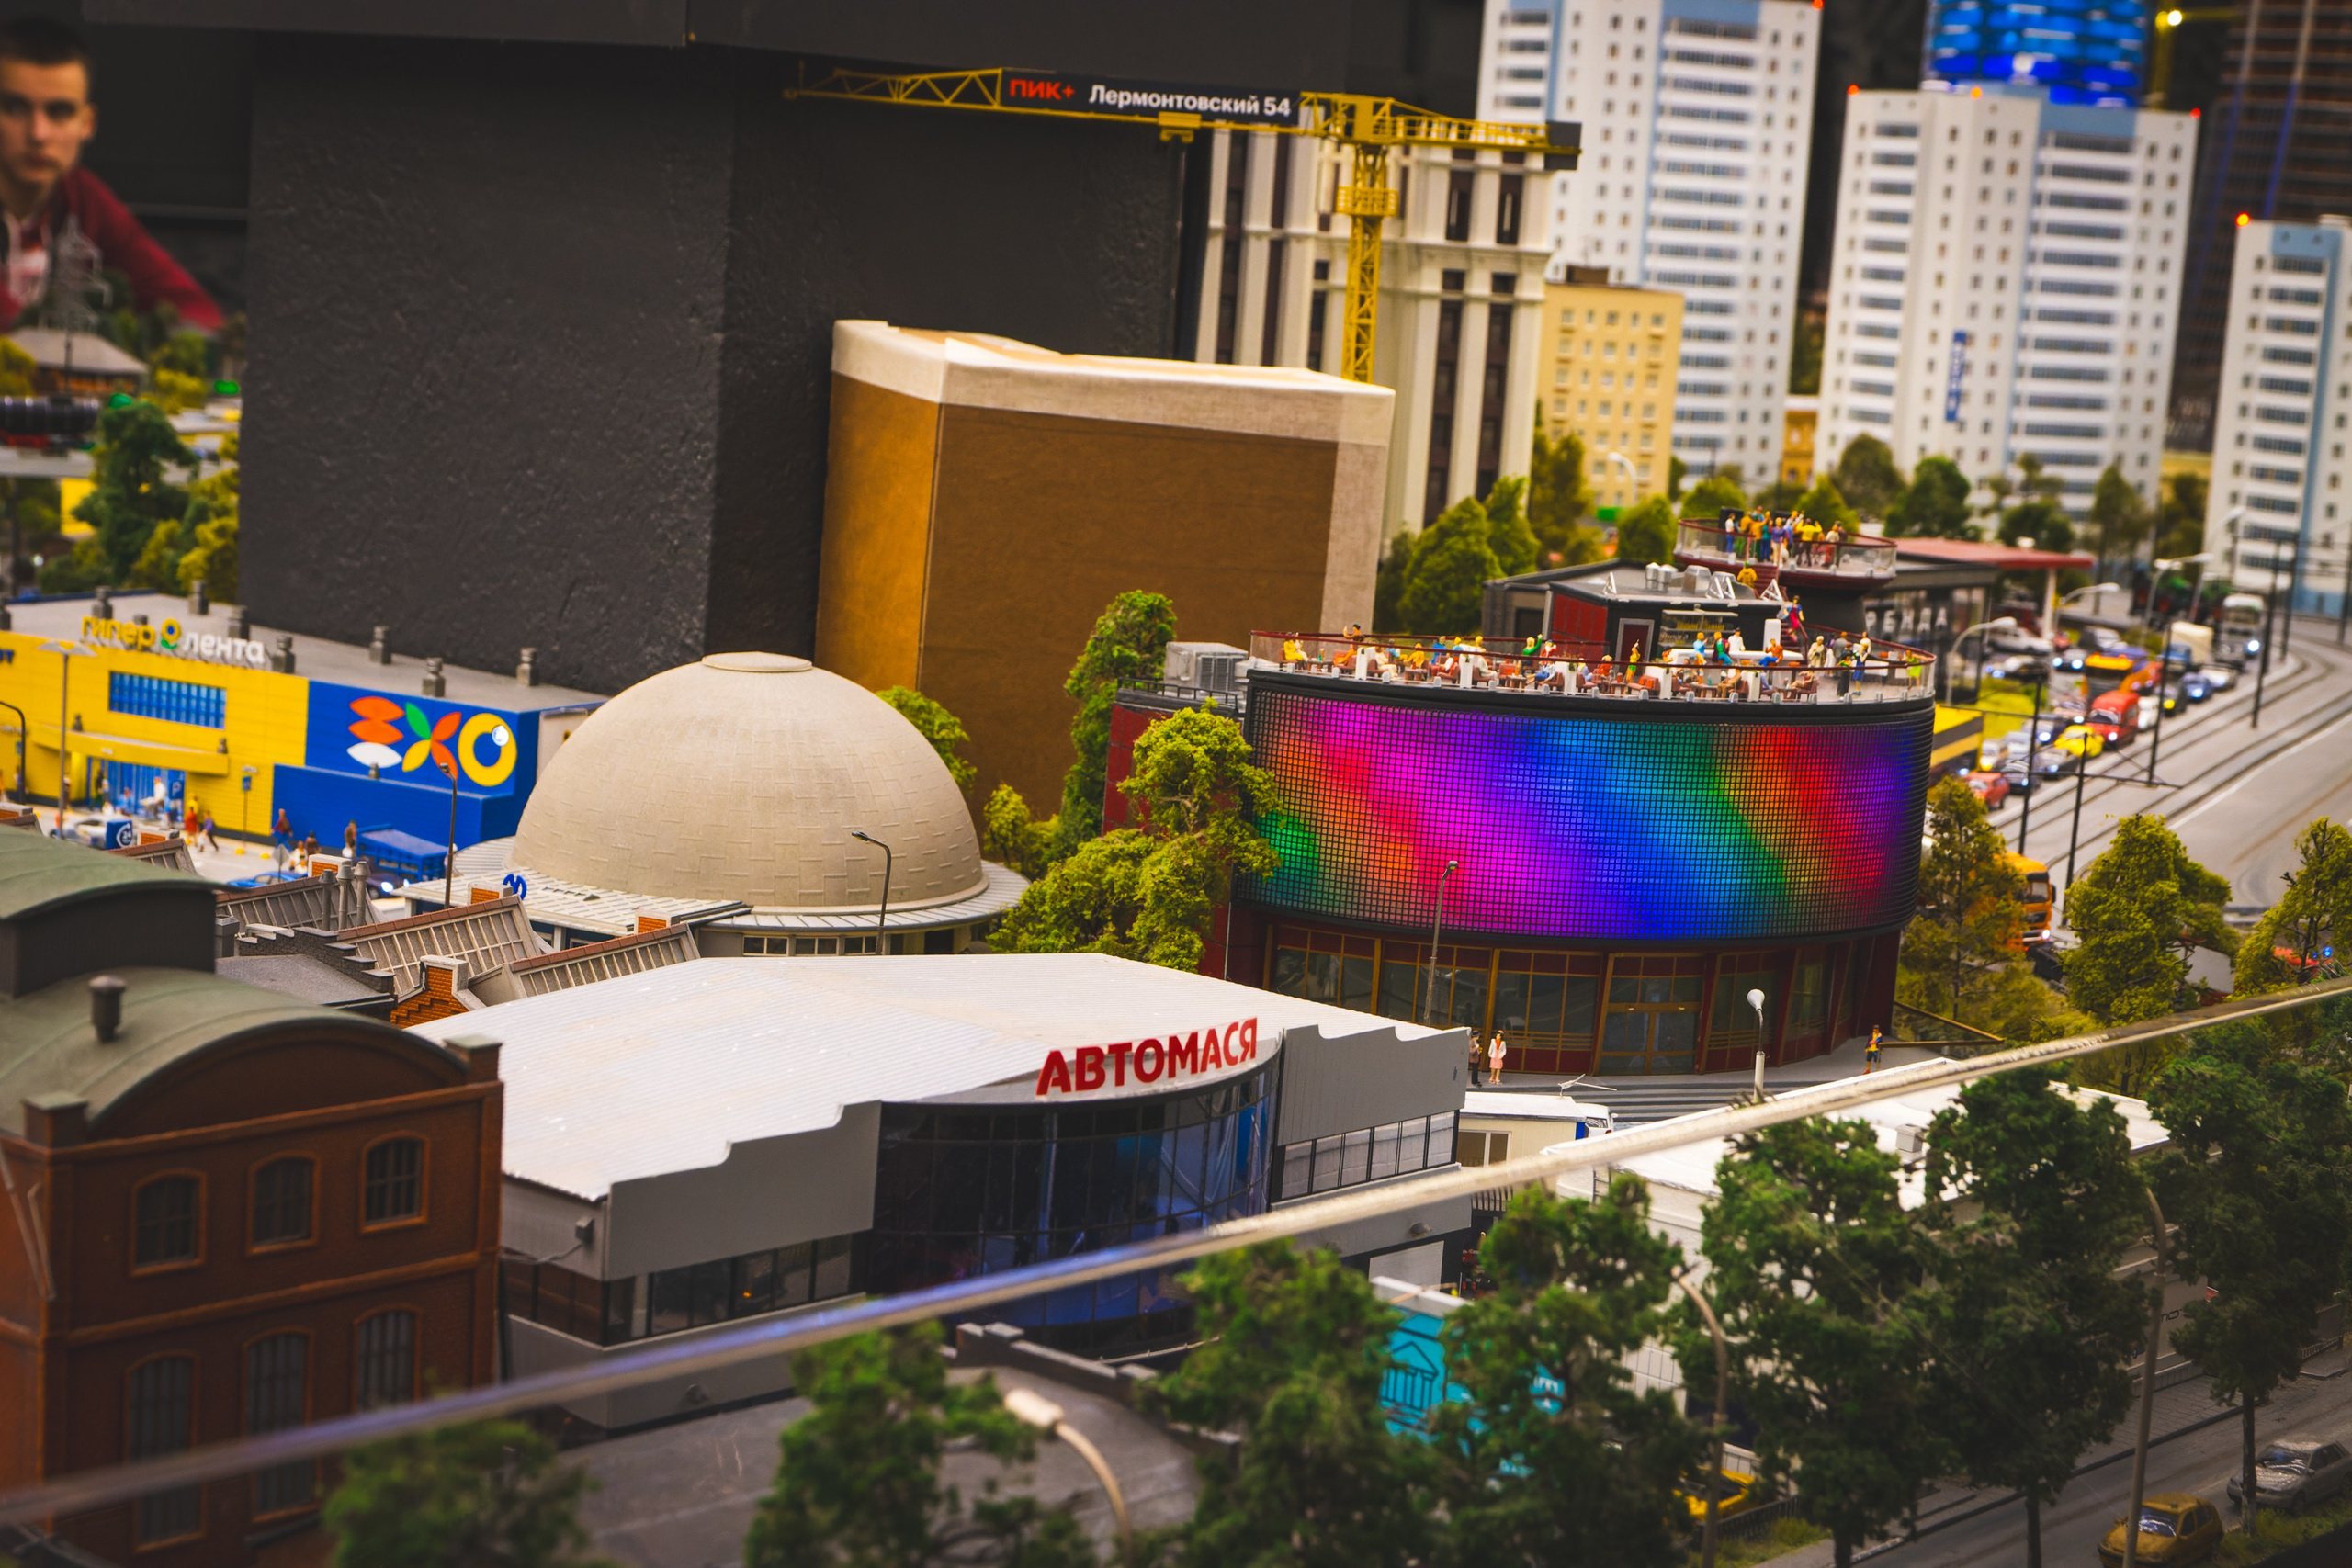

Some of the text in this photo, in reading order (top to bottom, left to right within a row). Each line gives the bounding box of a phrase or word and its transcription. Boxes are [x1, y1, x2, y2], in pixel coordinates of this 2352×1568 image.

[1011, 79, 1291, 117] ПИК+ Лермонтовский 54
[82, 615, 266, 664] гипер лента
[1035, 1016, 1258, 1097] АВТОМАСЯ
